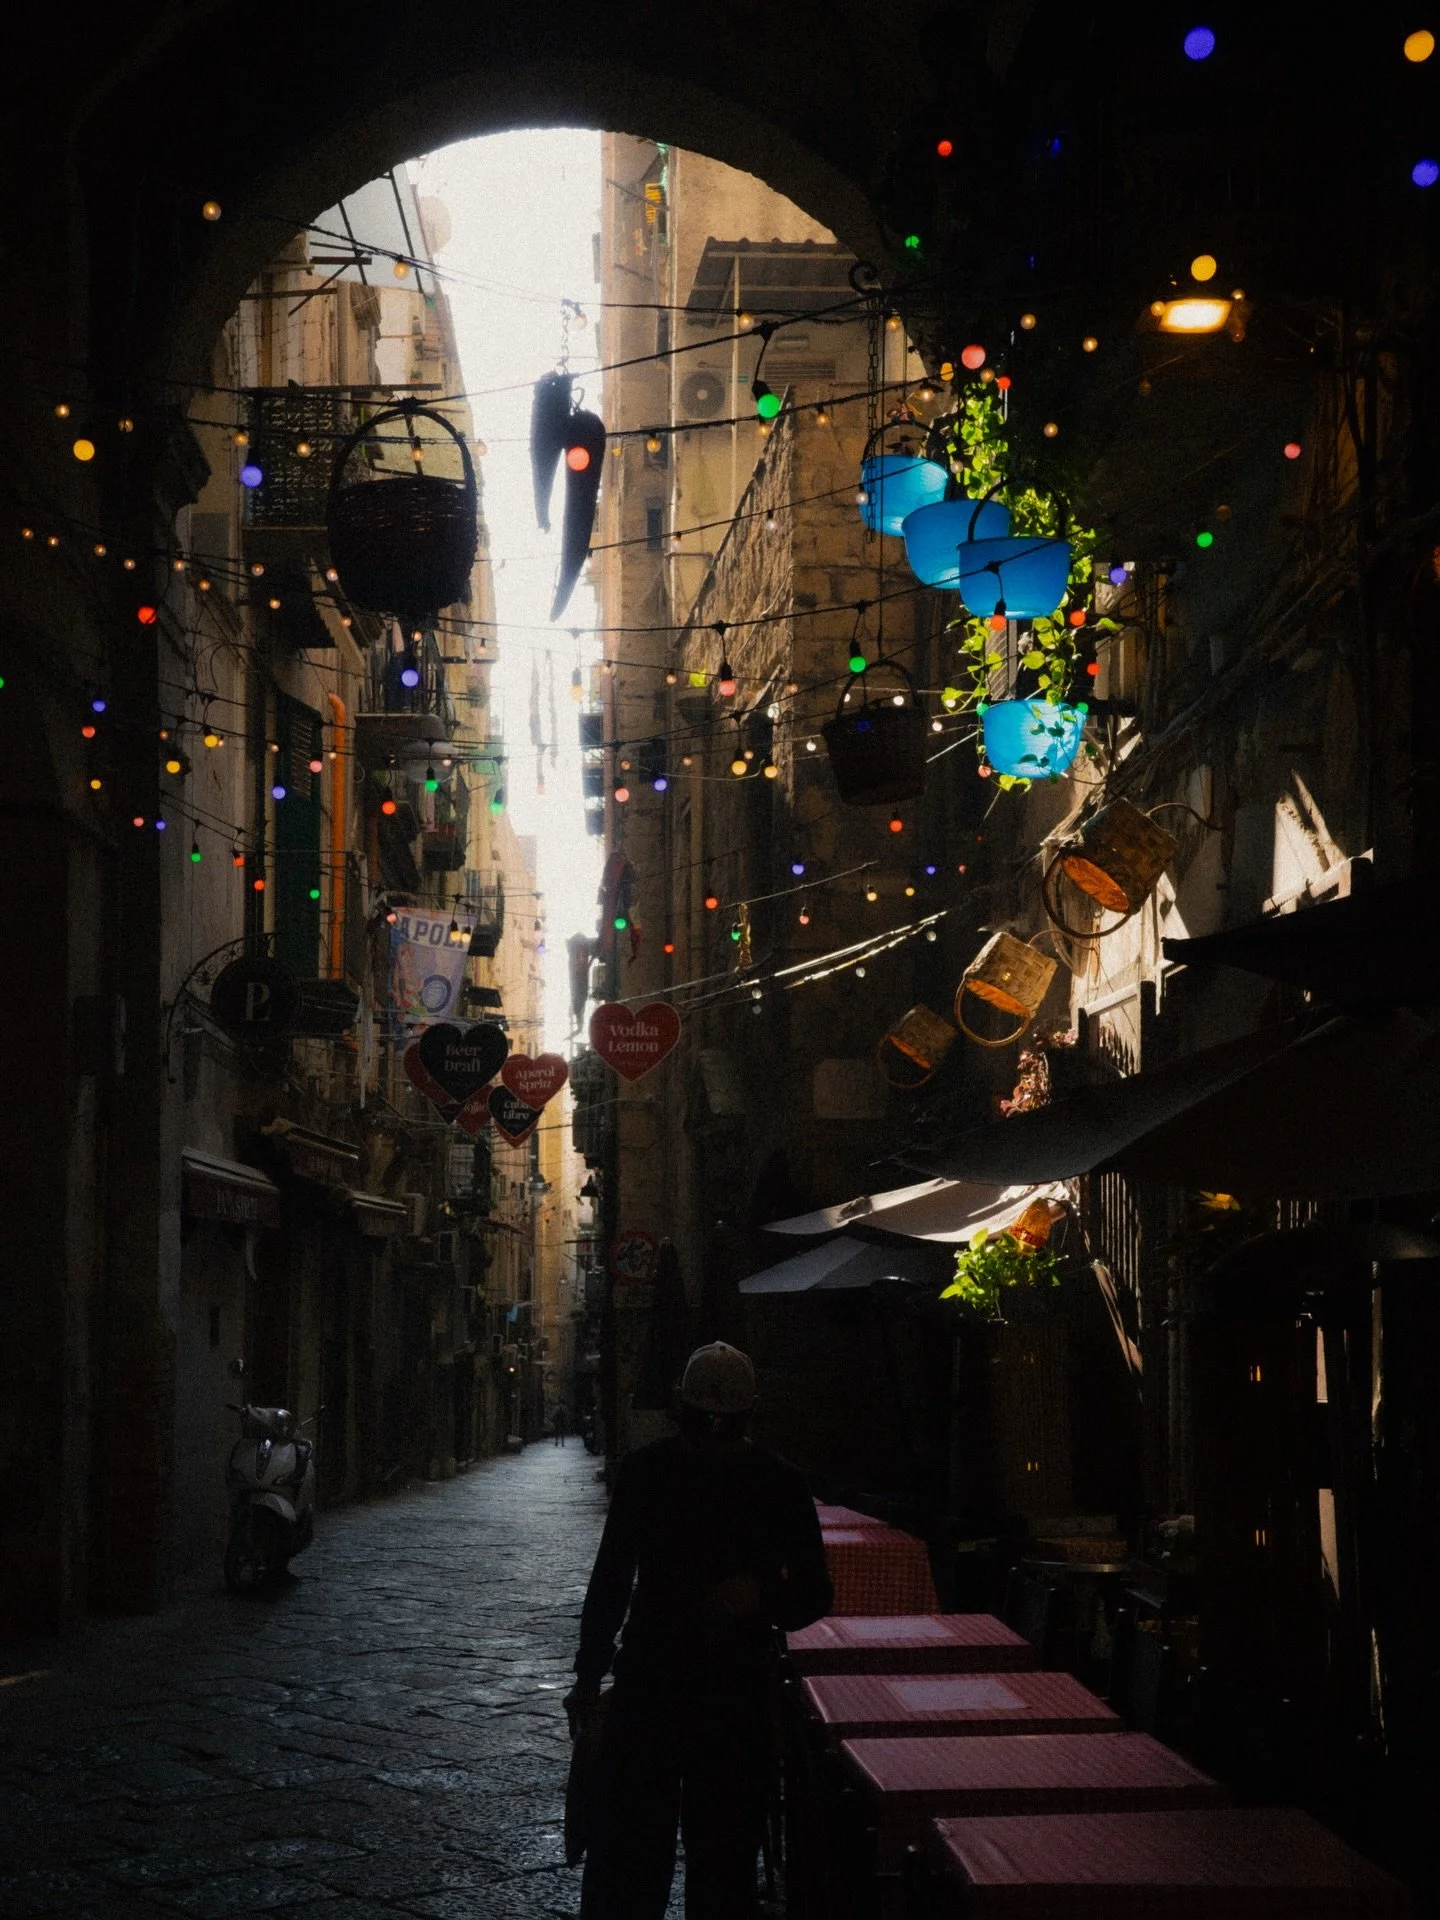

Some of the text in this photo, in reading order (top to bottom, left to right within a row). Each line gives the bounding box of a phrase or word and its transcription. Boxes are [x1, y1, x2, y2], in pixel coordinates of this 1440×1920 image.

[609, 1021, 659, 1037] Vodka
[445, 1043, 481, 1056] Beer
[608, 1040, 659, 1052] Lemon
[444, 1058, 481, 1072] Draft
[515, 1066, 555, 1081] Aperol
[519, 1080, 552, 1092] Spritz
[503, 1109, 530, 1120] Libre
